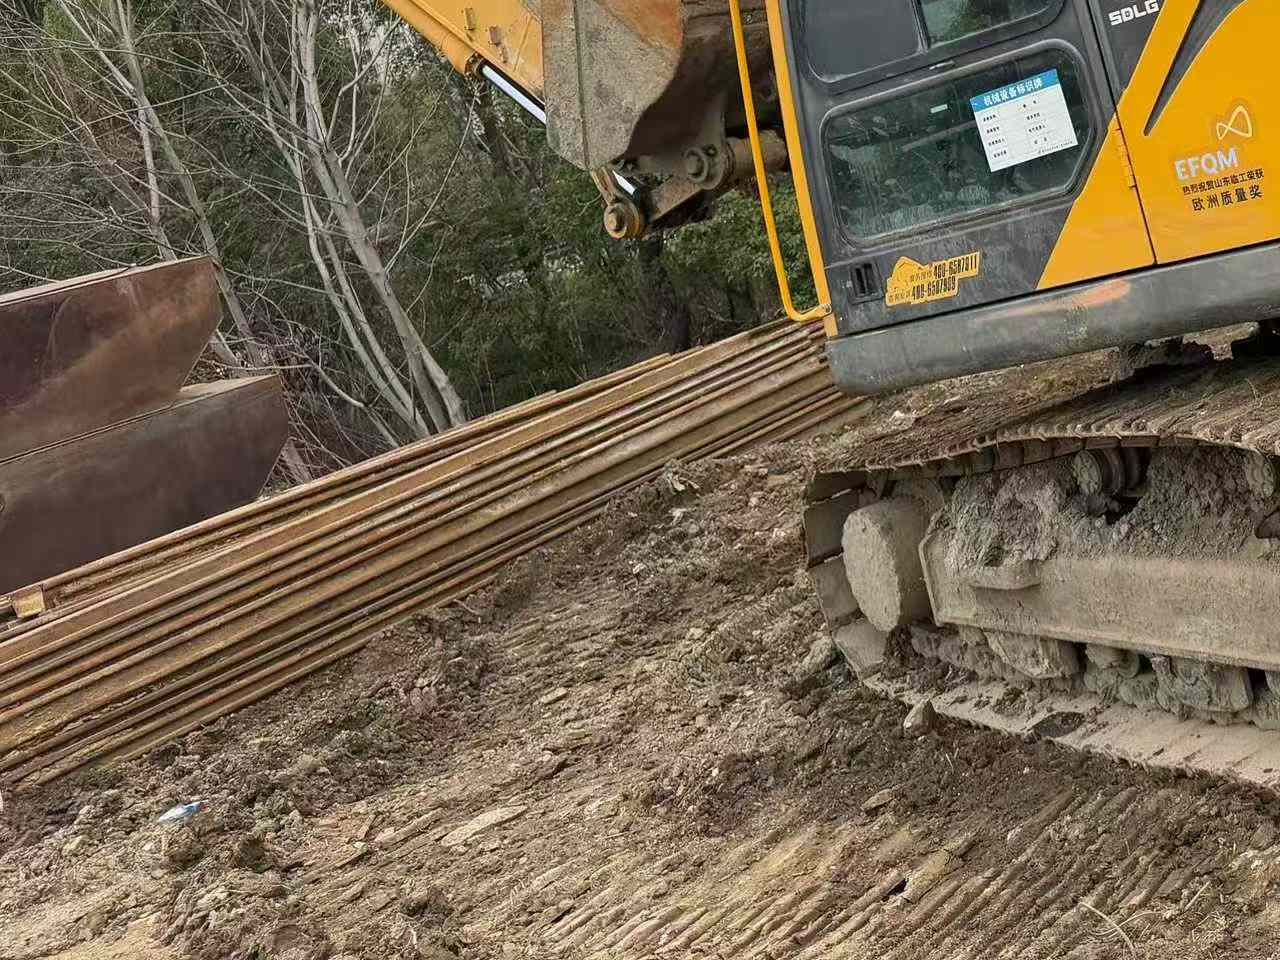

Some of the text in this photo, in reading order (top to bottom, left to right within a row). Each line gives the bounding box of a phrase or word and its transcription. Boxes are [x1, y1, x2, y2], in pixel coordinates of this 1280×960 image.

[983, 77, 1043, 107] 机械设备标识牌
[1174, 147, 1239, 180] EFQM
[1191, 185, 1263, 212] 欧洲质量奖
